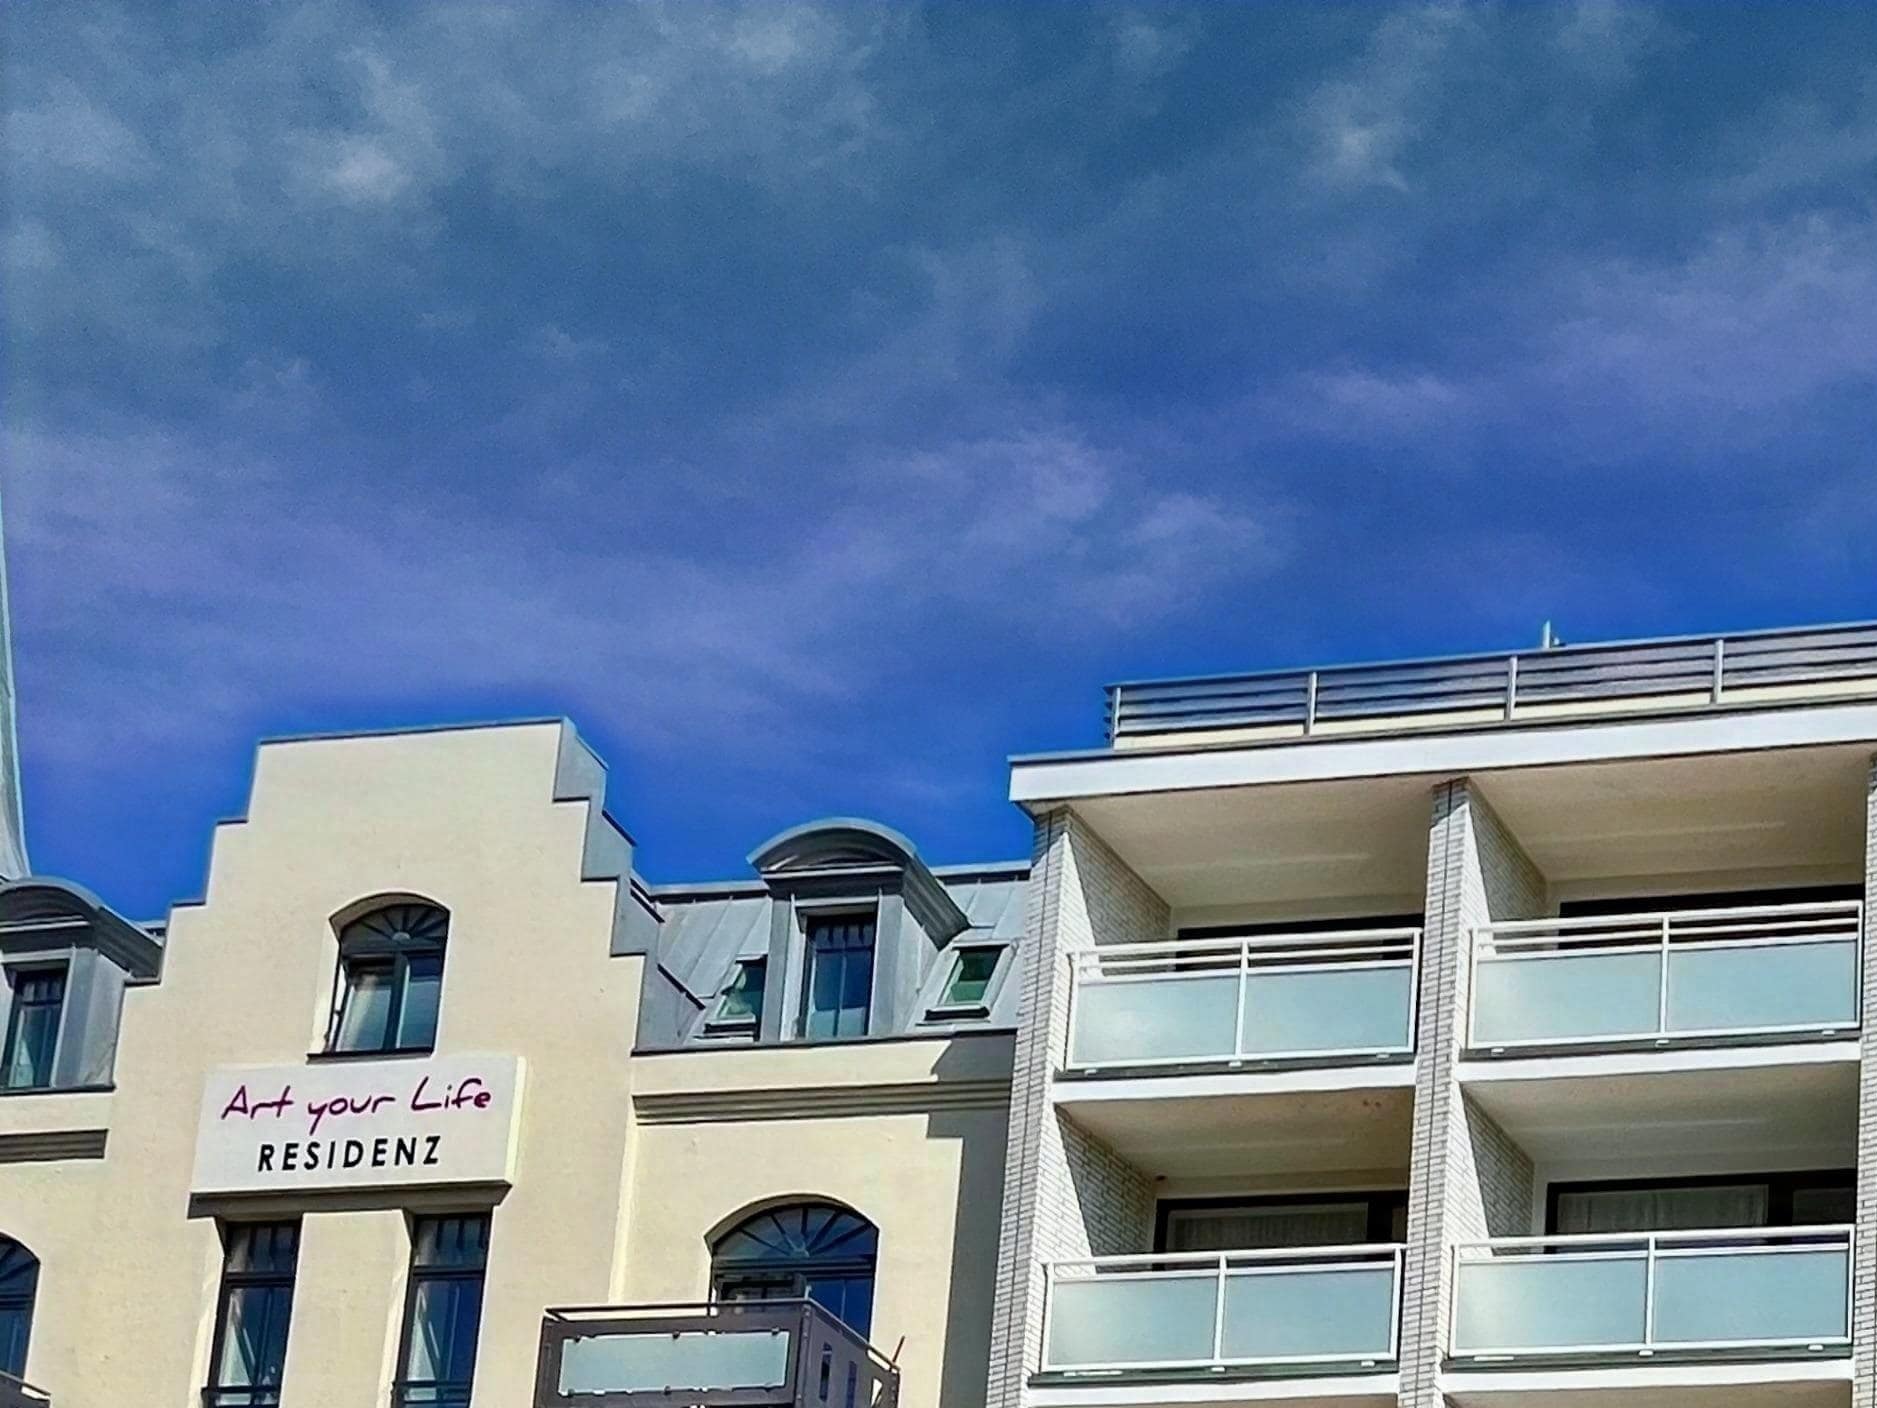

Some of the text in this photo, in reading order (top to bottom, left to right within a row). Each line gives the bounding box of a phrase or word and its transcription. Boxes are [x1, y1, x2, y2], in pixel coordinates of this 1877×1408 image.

[221, 1076, 492, 1136] Art your Life
[258, 1135, 441, 1172] RESIDENZ
